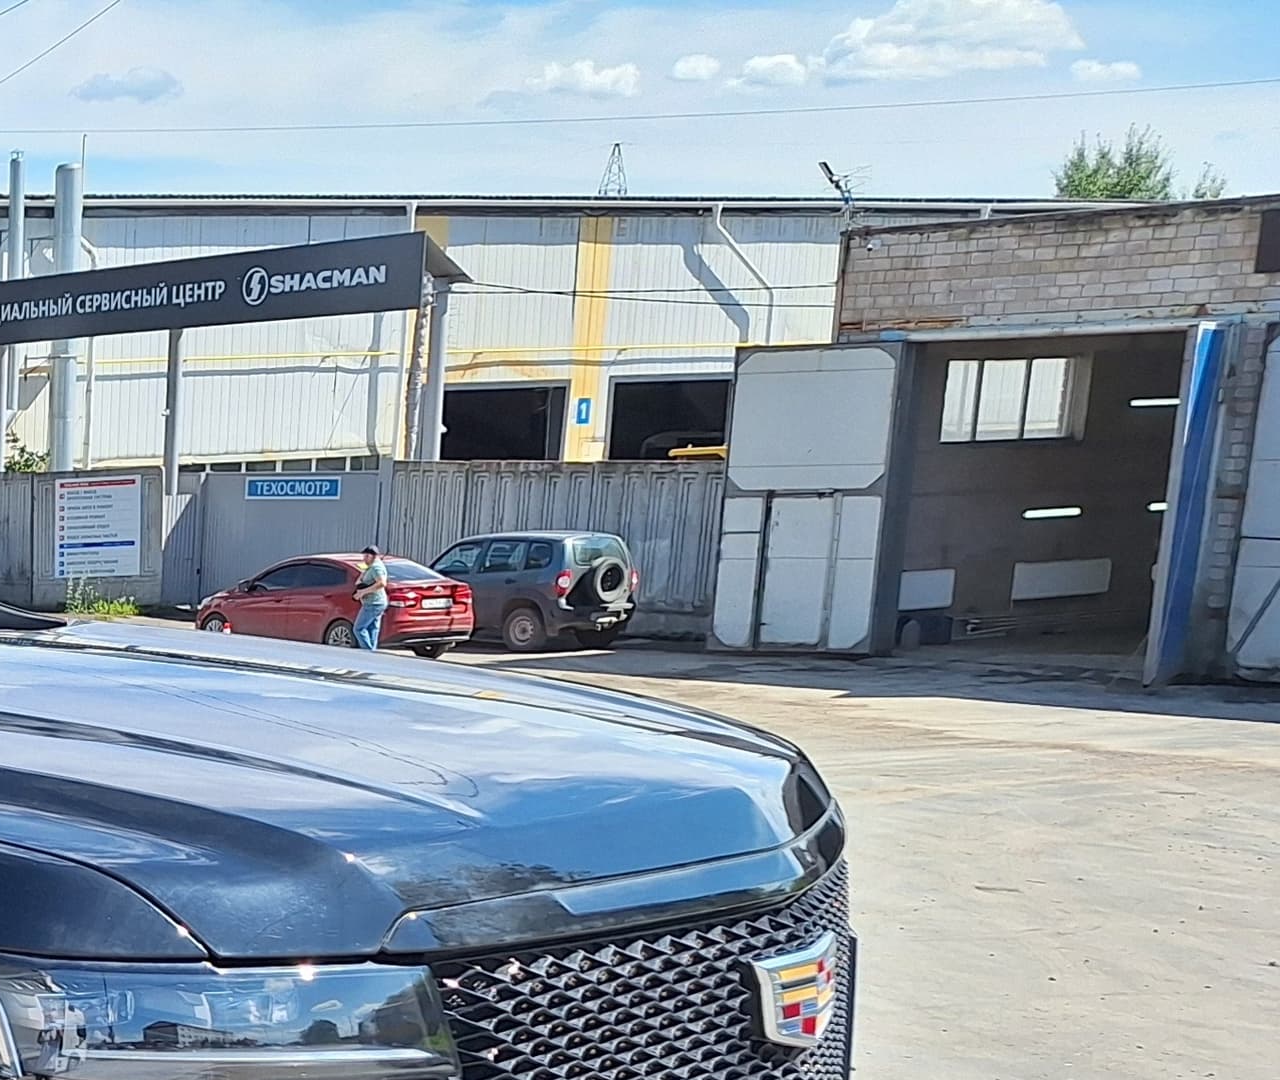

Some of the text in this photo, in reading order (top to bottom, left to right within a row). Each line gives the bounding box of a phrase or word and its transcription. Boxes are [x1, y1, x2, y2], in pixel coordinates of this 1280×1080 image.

[269, 265, 386, 294] SHACMAN
[75, 282, 168, 314] СЕРВИСНЫЙ
[172, 281, 226, 308] ЦЕНТР
[256, 481, 331, 495] ТЕХОСМОТР
